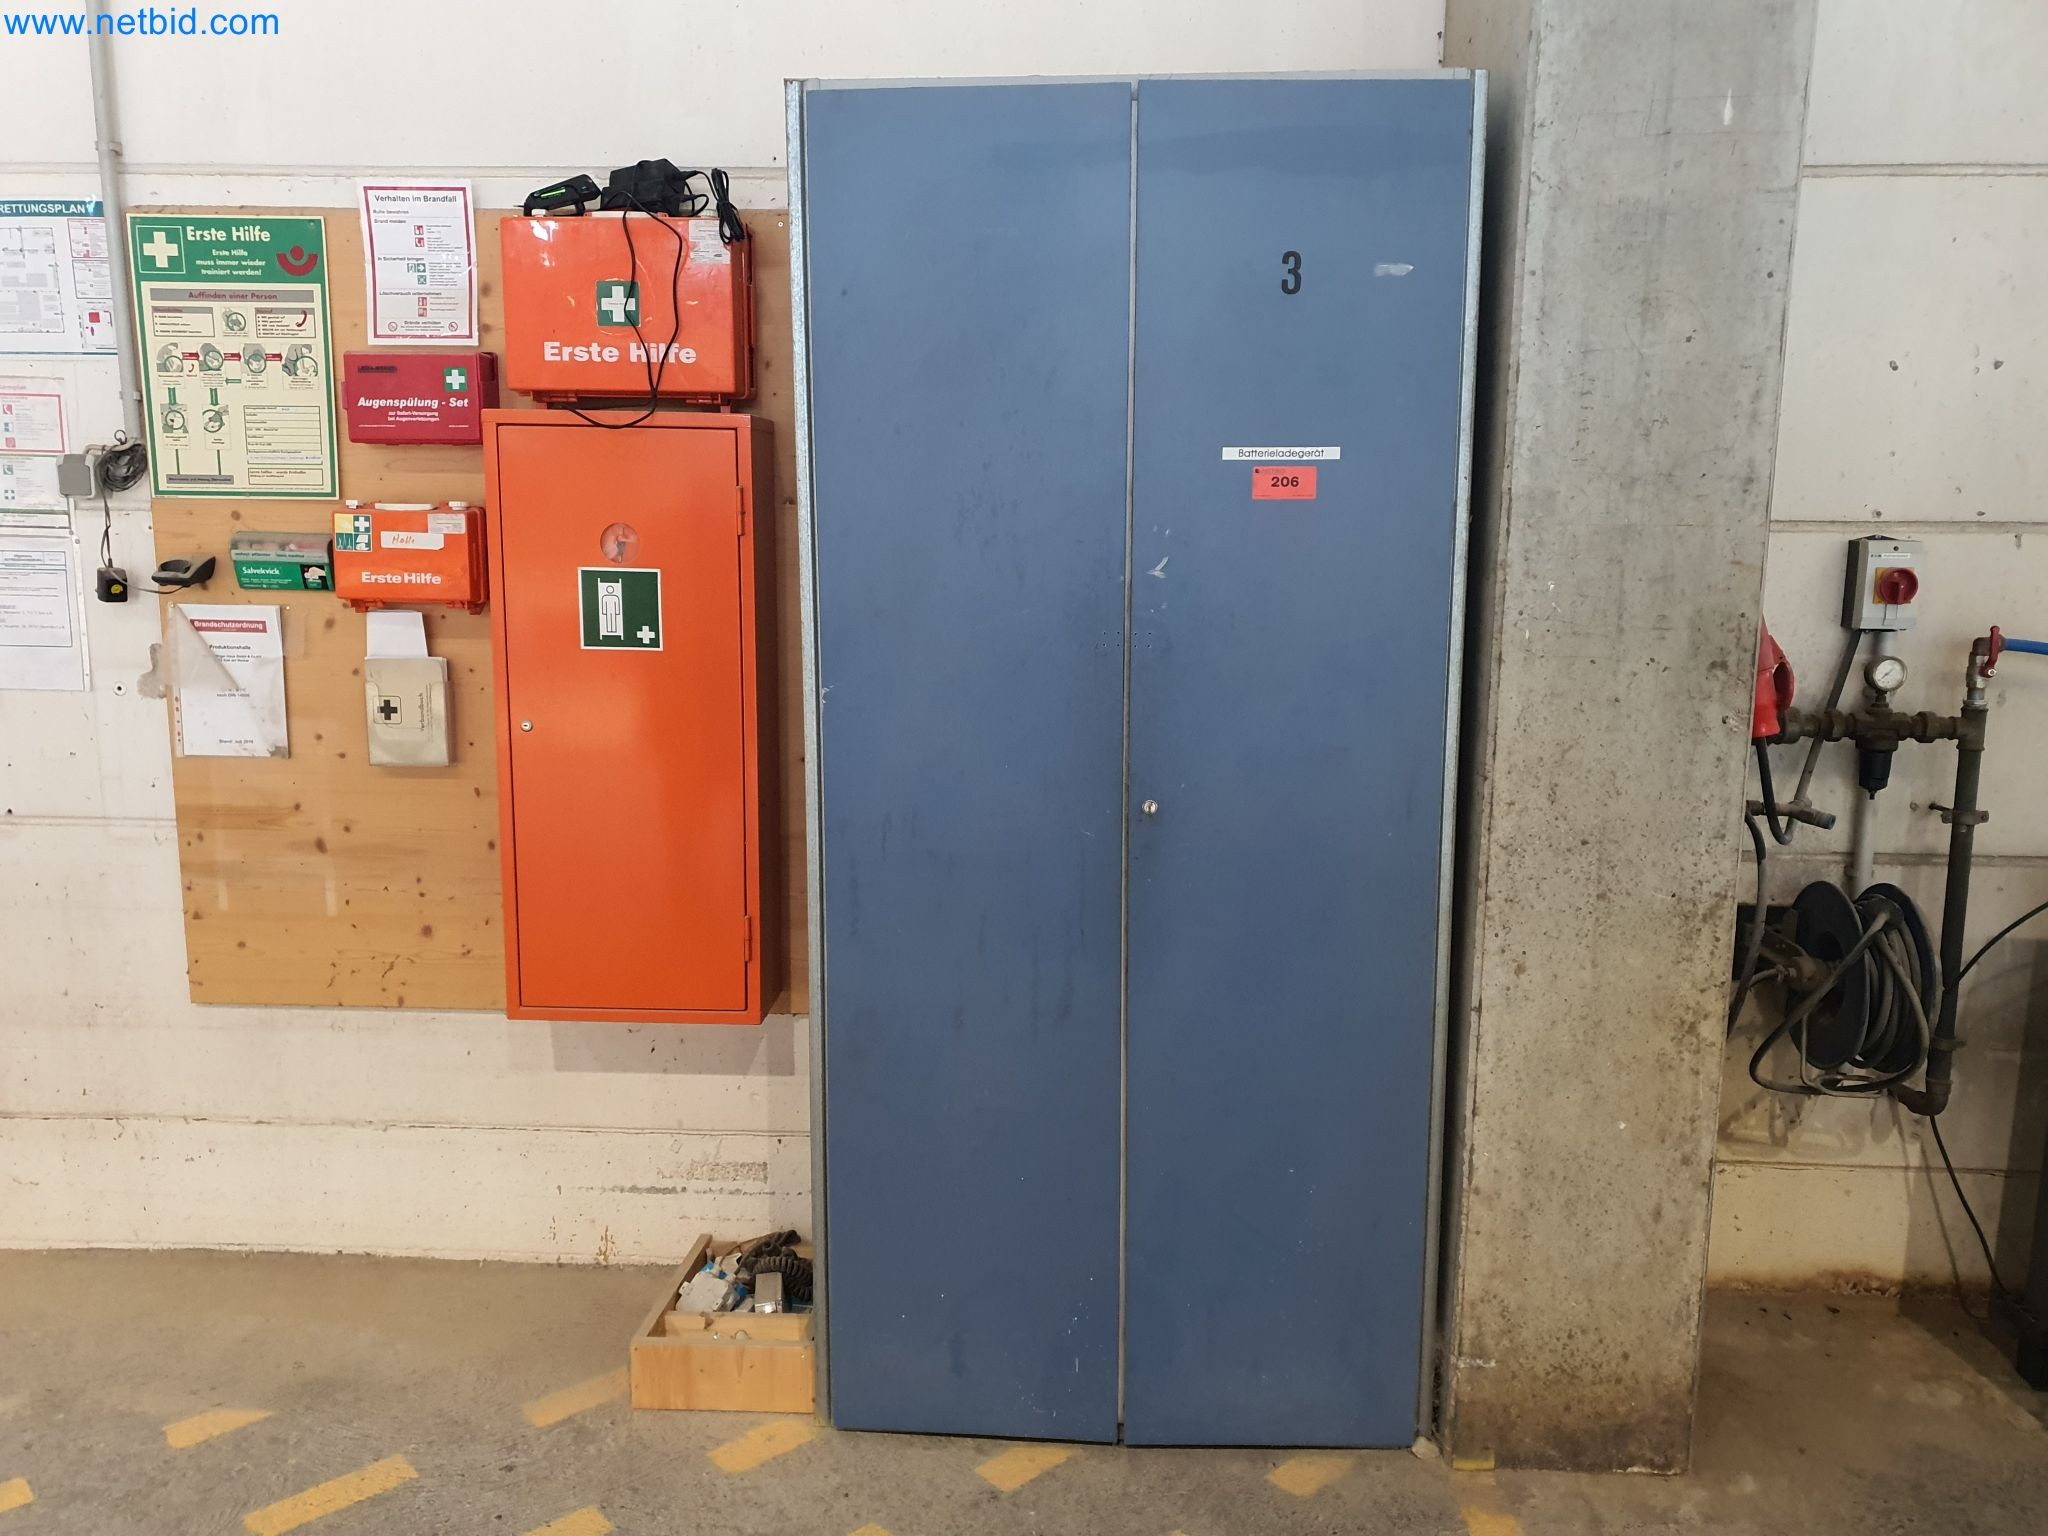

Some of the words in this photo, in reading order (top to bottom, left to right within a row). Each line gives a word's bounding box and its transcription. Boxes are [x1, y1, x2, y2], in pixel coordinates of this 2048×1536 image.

[374, 194, 411, 203] Verhalten
[412, 195, 422, 203] im
[423, 195, 457, 203] Brandfall
[0, 203, 85, 214] RETTUNGSPLAN
[186, 225, 227, 241] Erste
[232, 225, 271, 242] Hilfe
[216, 258, 239, 266] immer
[241, 259, 266, 267] wieder
[1281, 250, 1302, 295] 3
[188, 291, 227, 300] Auffinden
[250, 292, 278, 300] Person
[543, 341, 620, 363] Erste
[629, 342, 697, 364] Hilfe
[357, 396, 439, 409] Augenspülung
[448, 397, 469, 408] Set
[1238, 447, 1325, 459] Batterieladegerät
[1271, 476, 1300, 488] 206
[361, 571, 402, 584] Erste
[403, 572, 442, 585] Hilfe
[193, 620, 264, 630] Brandschutzordnung
